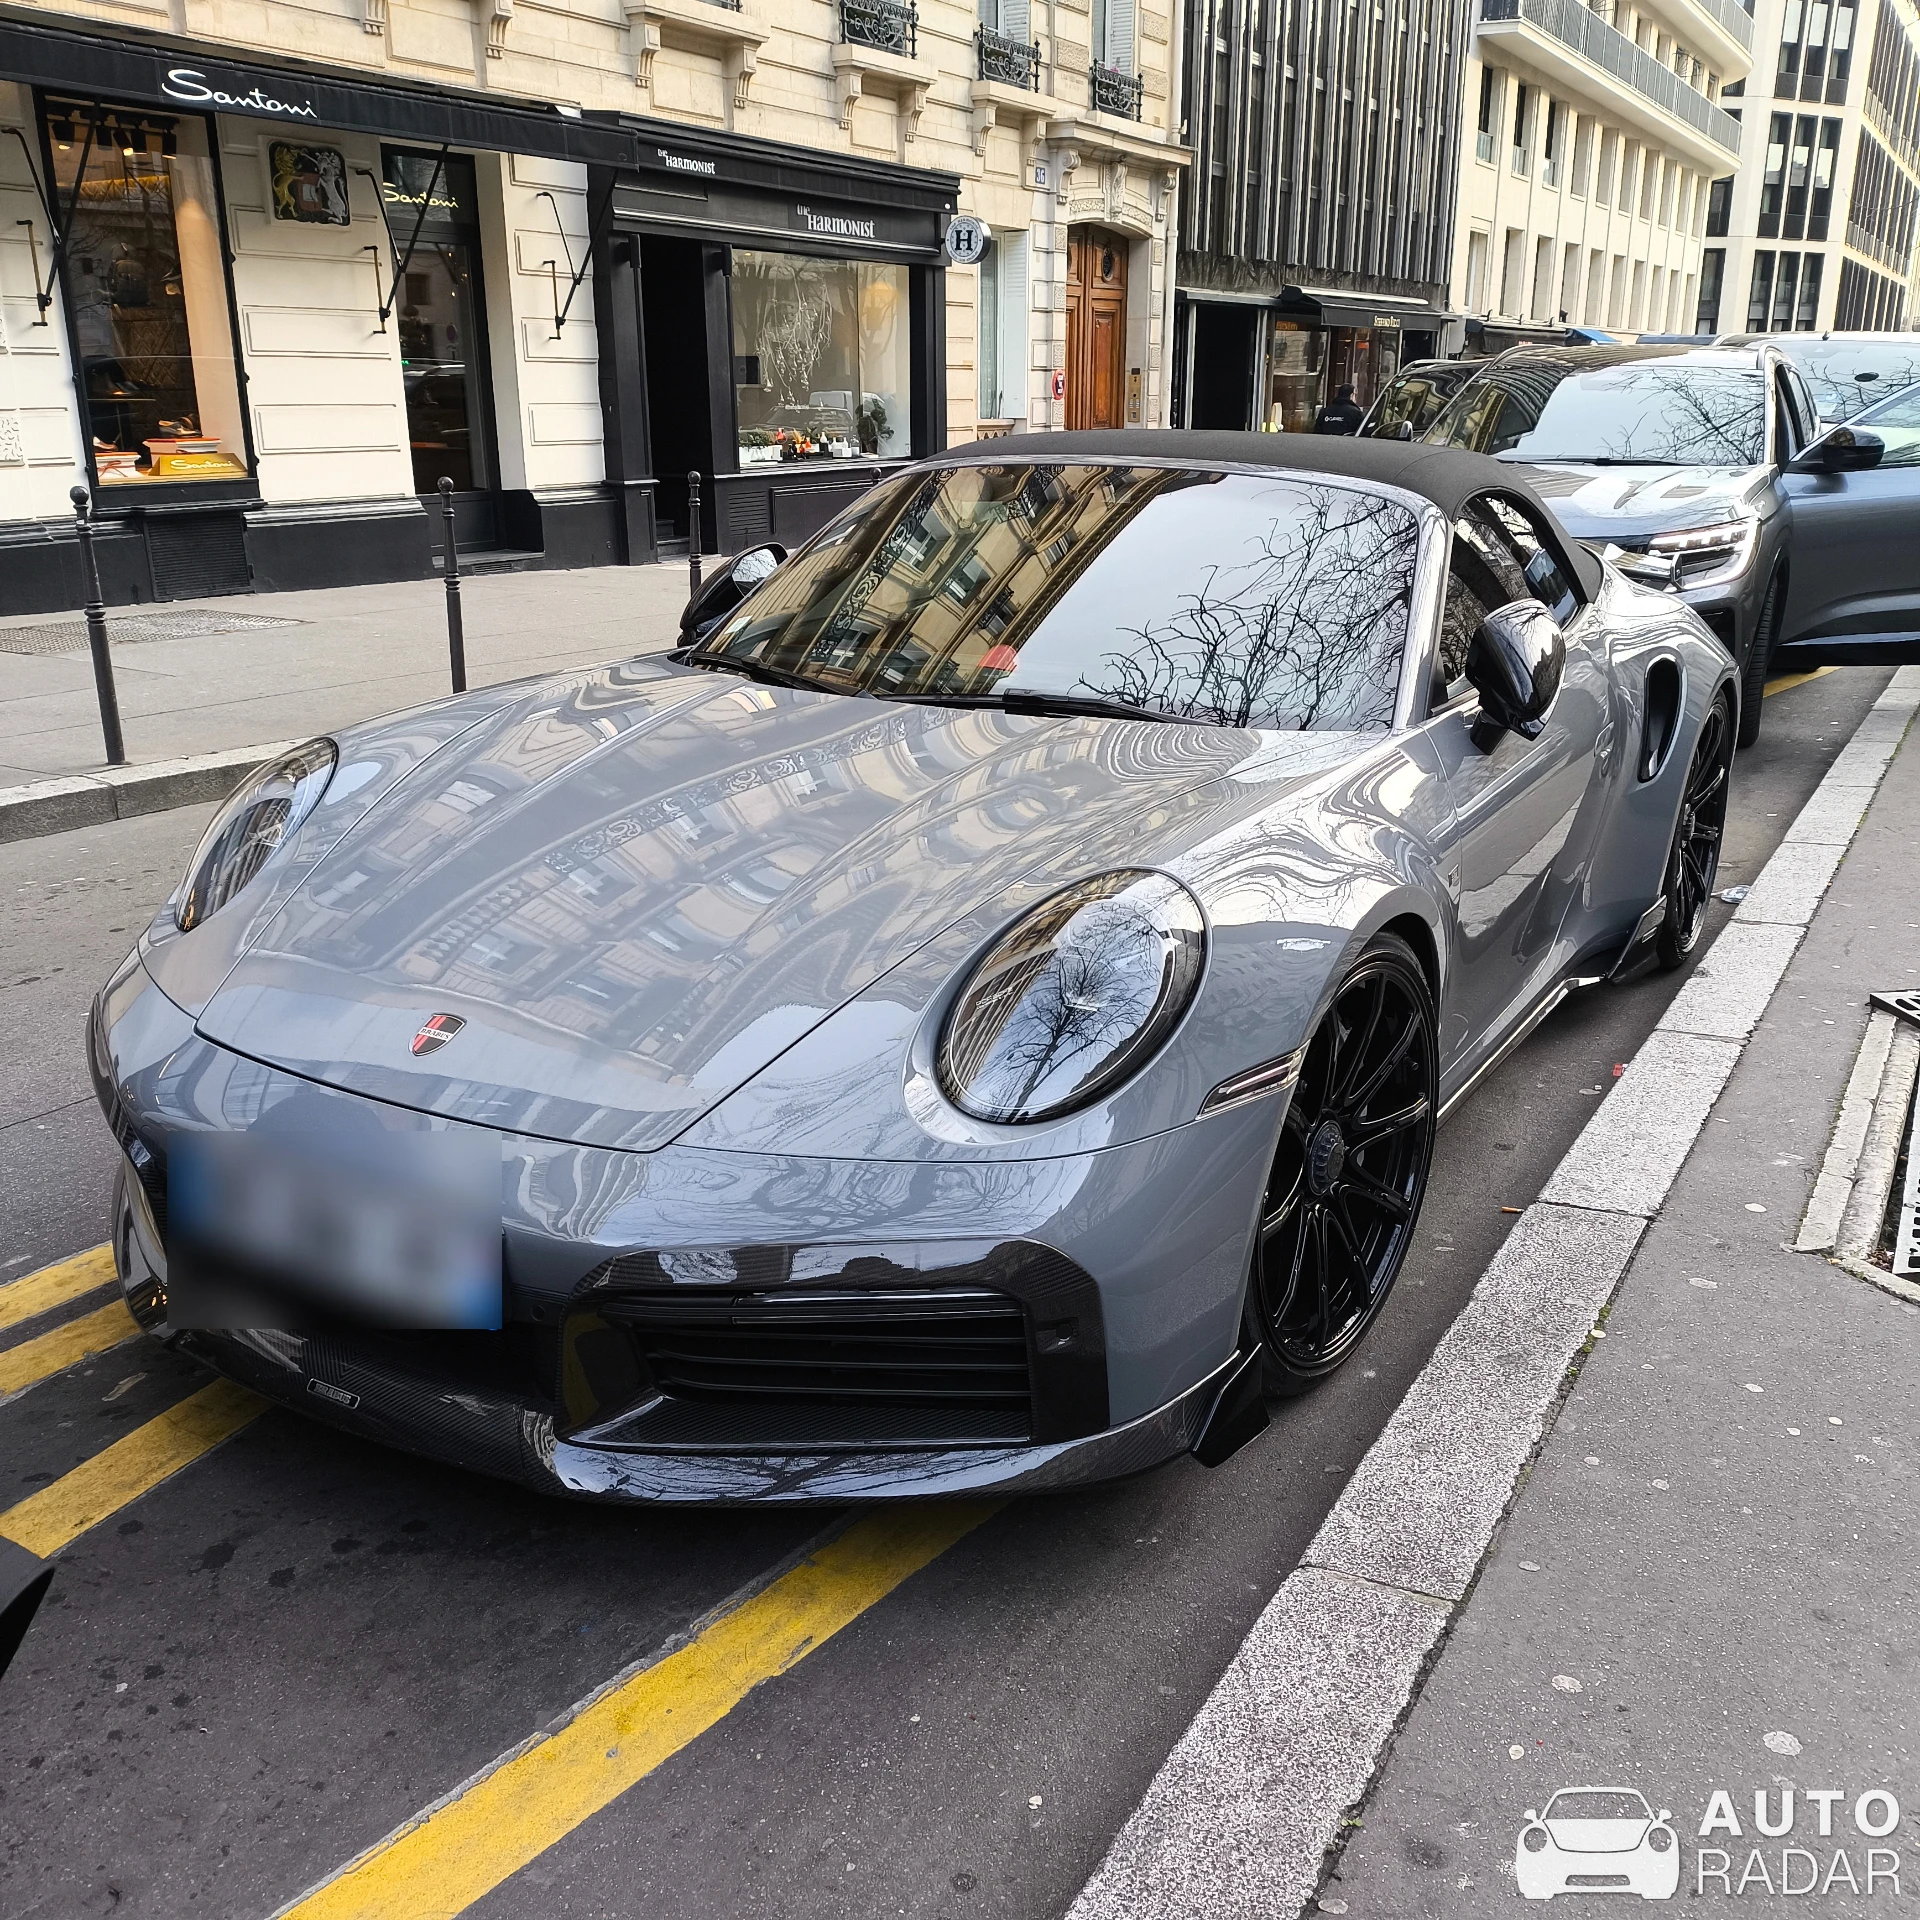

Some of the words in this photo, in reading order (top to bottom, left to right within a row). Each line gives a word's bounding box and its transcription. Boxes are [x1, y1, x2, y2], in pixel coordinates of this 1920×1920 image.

[161, 68, 317, 119] Santoni
[1036, 168, 1045, 183] 36
[807, 214, 875, 238] HARMONIST
[954, 229, 974, 251] H
[169, 459, 236, 471] Santoni
[420, 1028, 451, 1039] BRABUS
